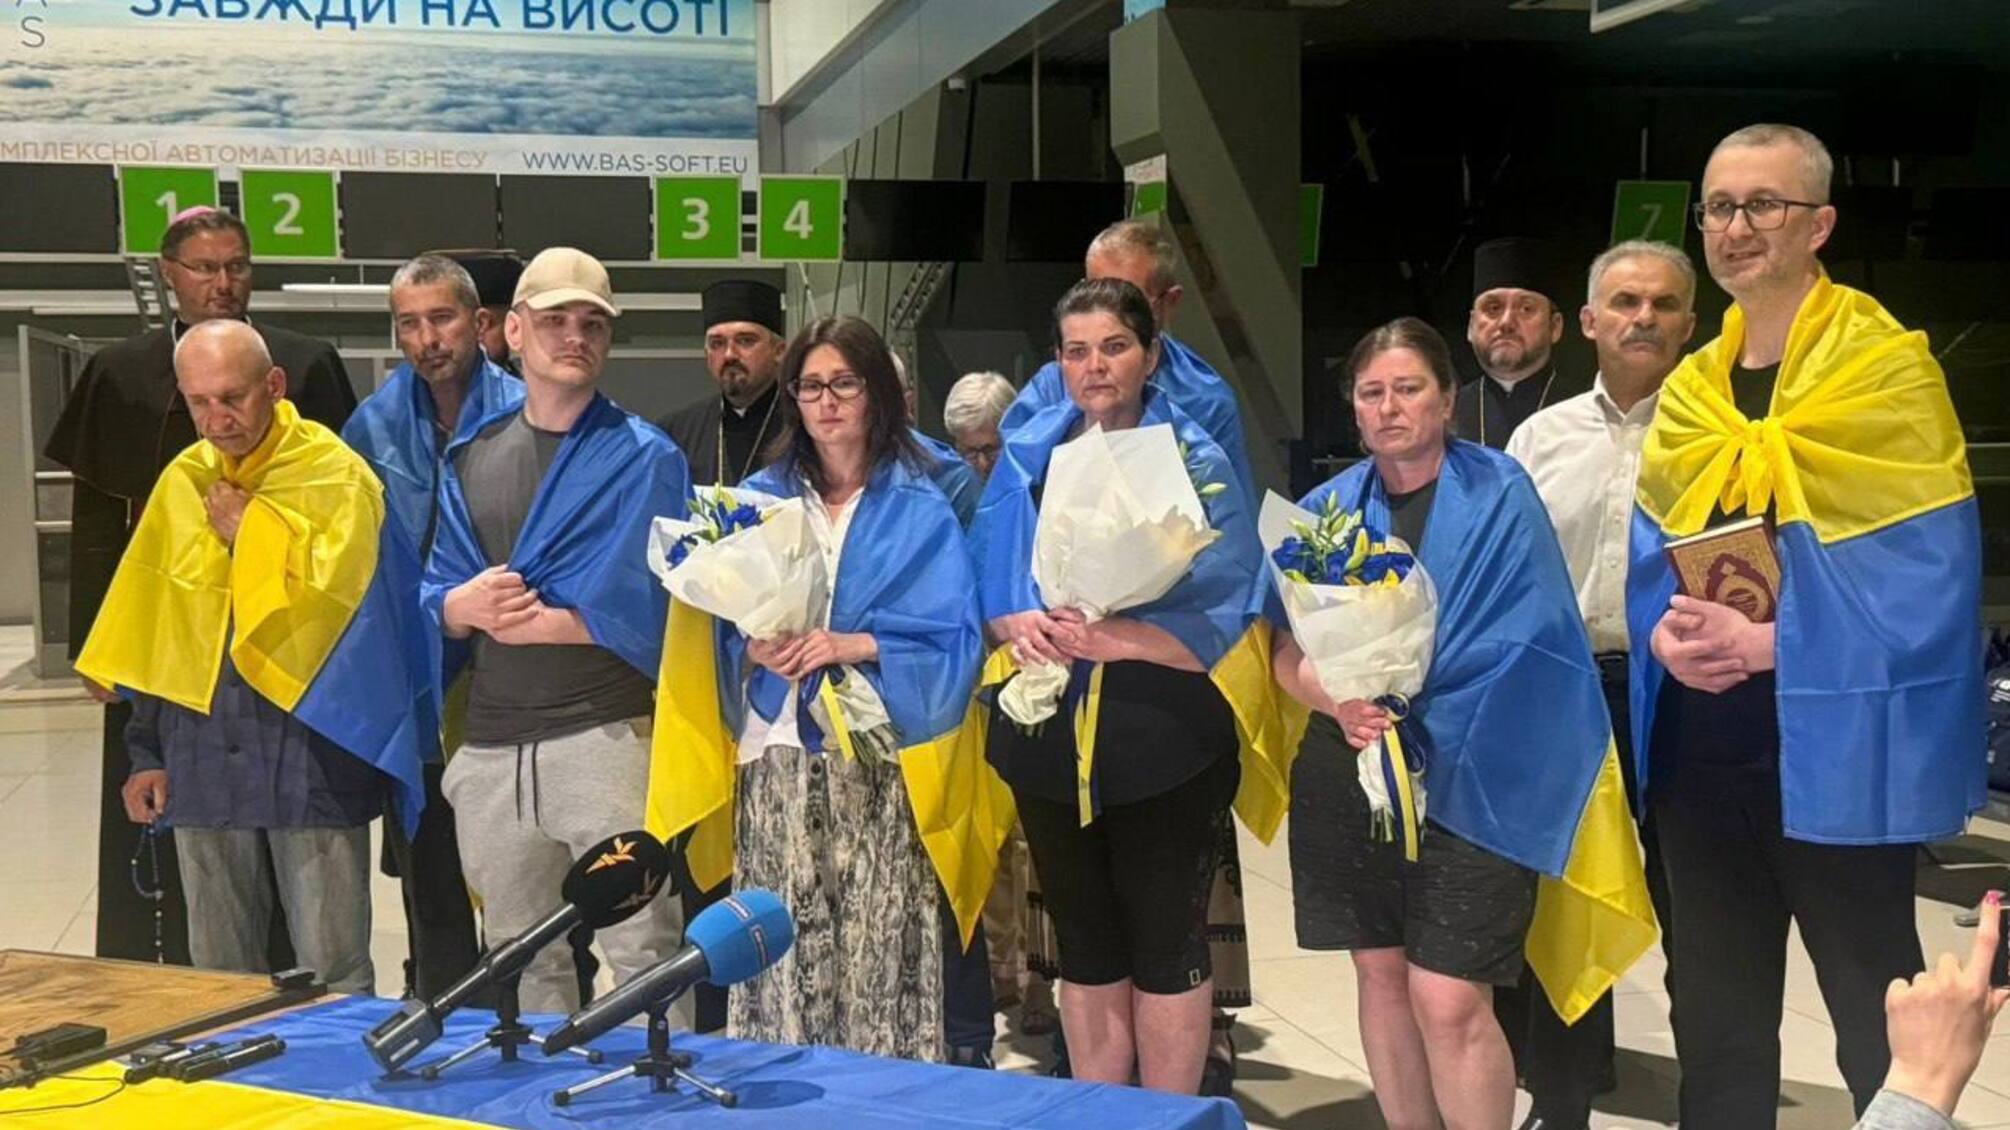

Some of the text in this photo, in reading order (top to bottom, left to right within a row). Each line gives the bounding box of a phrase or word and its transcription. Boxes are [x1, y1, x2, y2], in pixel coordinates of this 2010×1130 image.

[21, 16, 45, 48] S
[421, 0, 501, 27] НА
[523, 0, 728, 36] ВИСОТІ
[1, 141, 158, 162] МПЛЕКСНОЇ
[385, 148, 488, 169] БІЗНЕСУ
[523, 152, 748, 173] WWW.BAS-SOFT.EU
[155, 190, 177, 227] 1
[272, 192, 304, 235] 2
[681, 197, 711, 240] 3
[783, 199, 814, 240] 4
[1636, 203, 1663, 241] 7
